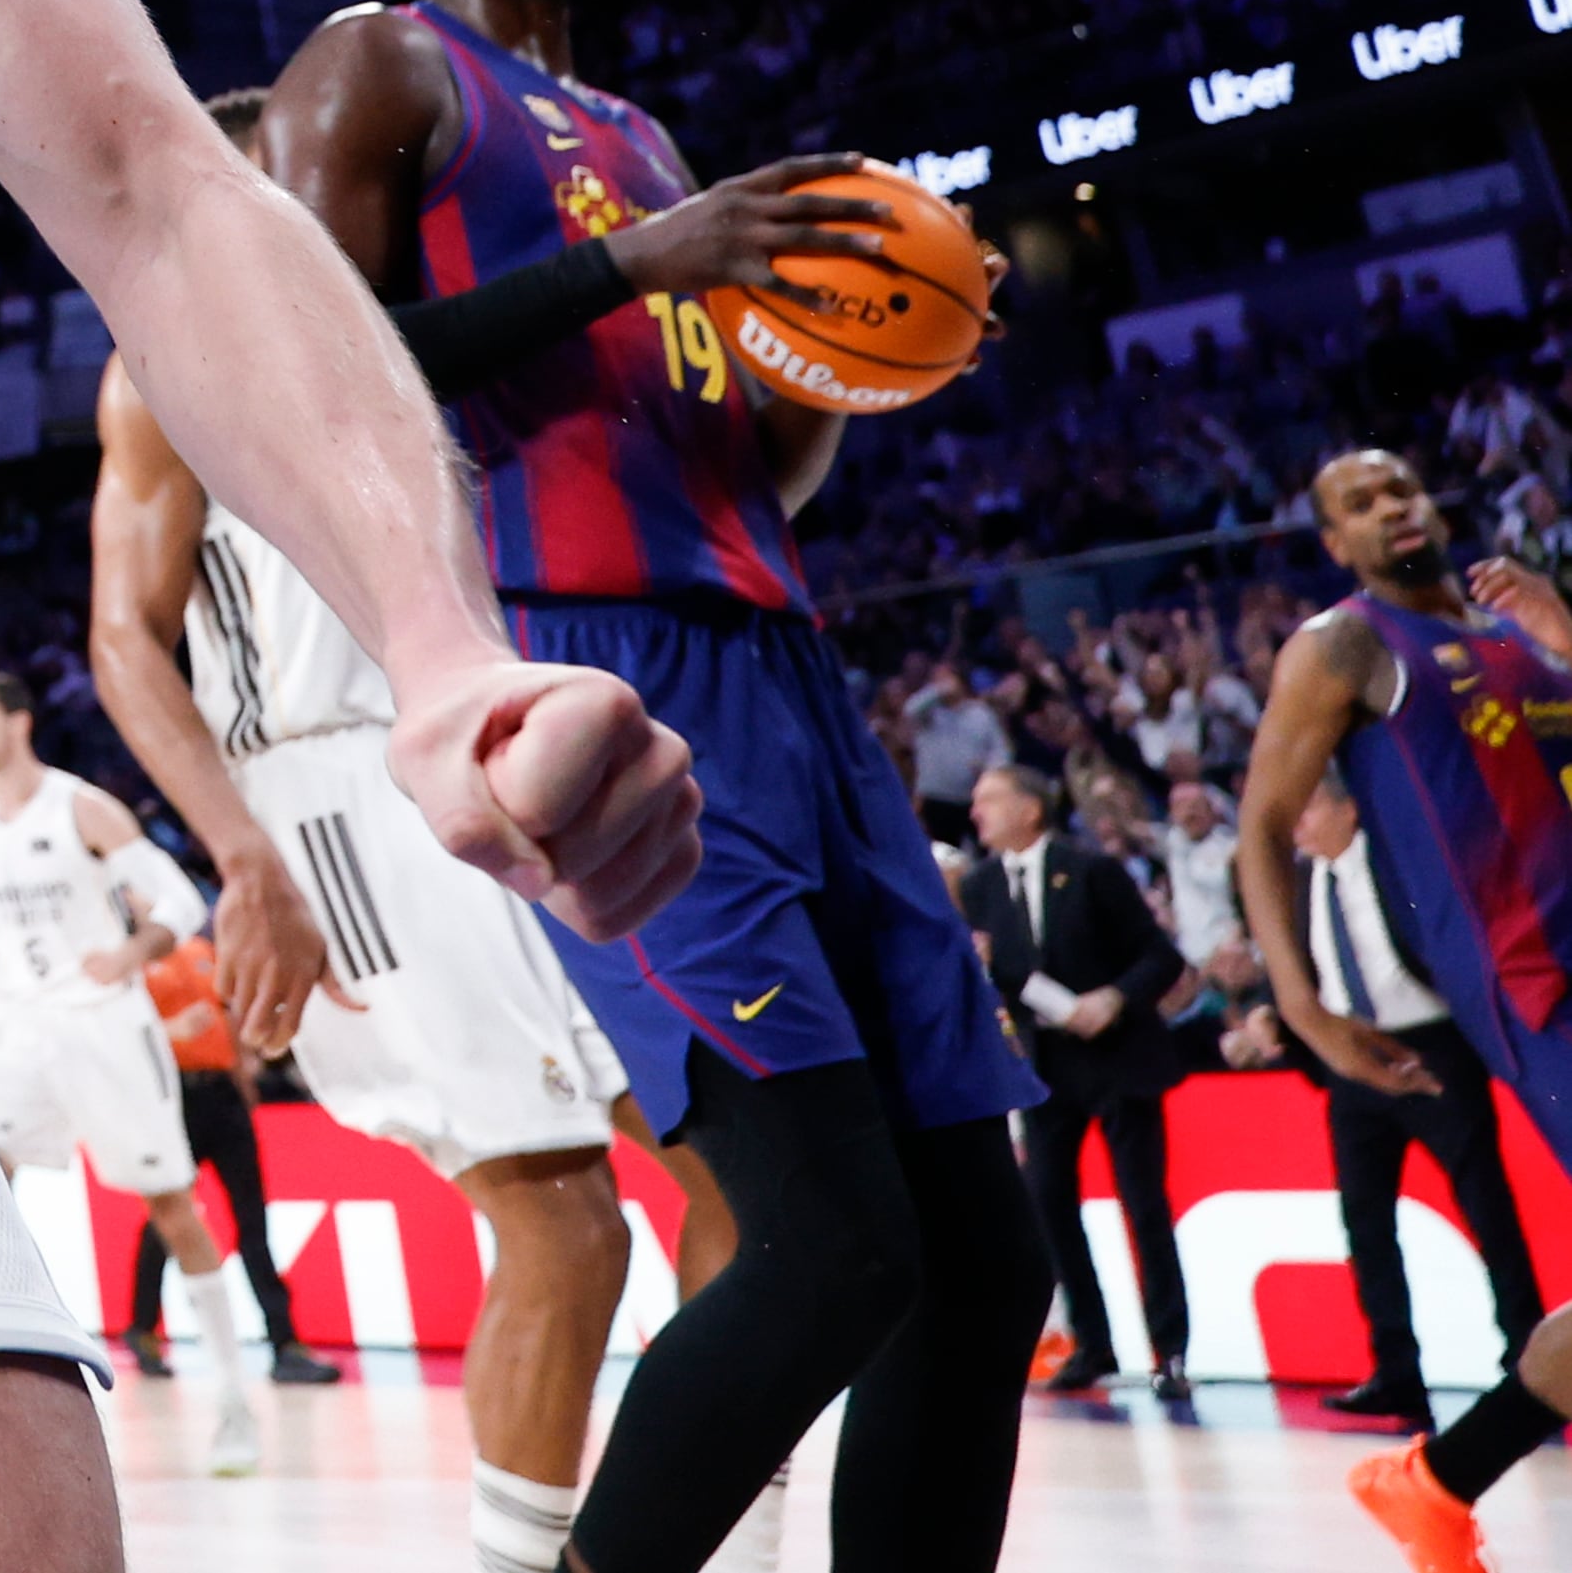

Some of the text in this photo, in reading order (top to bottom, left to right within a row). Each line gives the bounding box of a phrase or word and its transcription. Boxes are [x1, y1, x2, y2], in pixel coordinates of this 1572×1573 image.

[1352, 15, 1464, 81] Uber
[1189, 61, 1295, 125] Uber
[1039, 105, 1139, 165] Uber
[738, 310, 911, 405] Wilson
